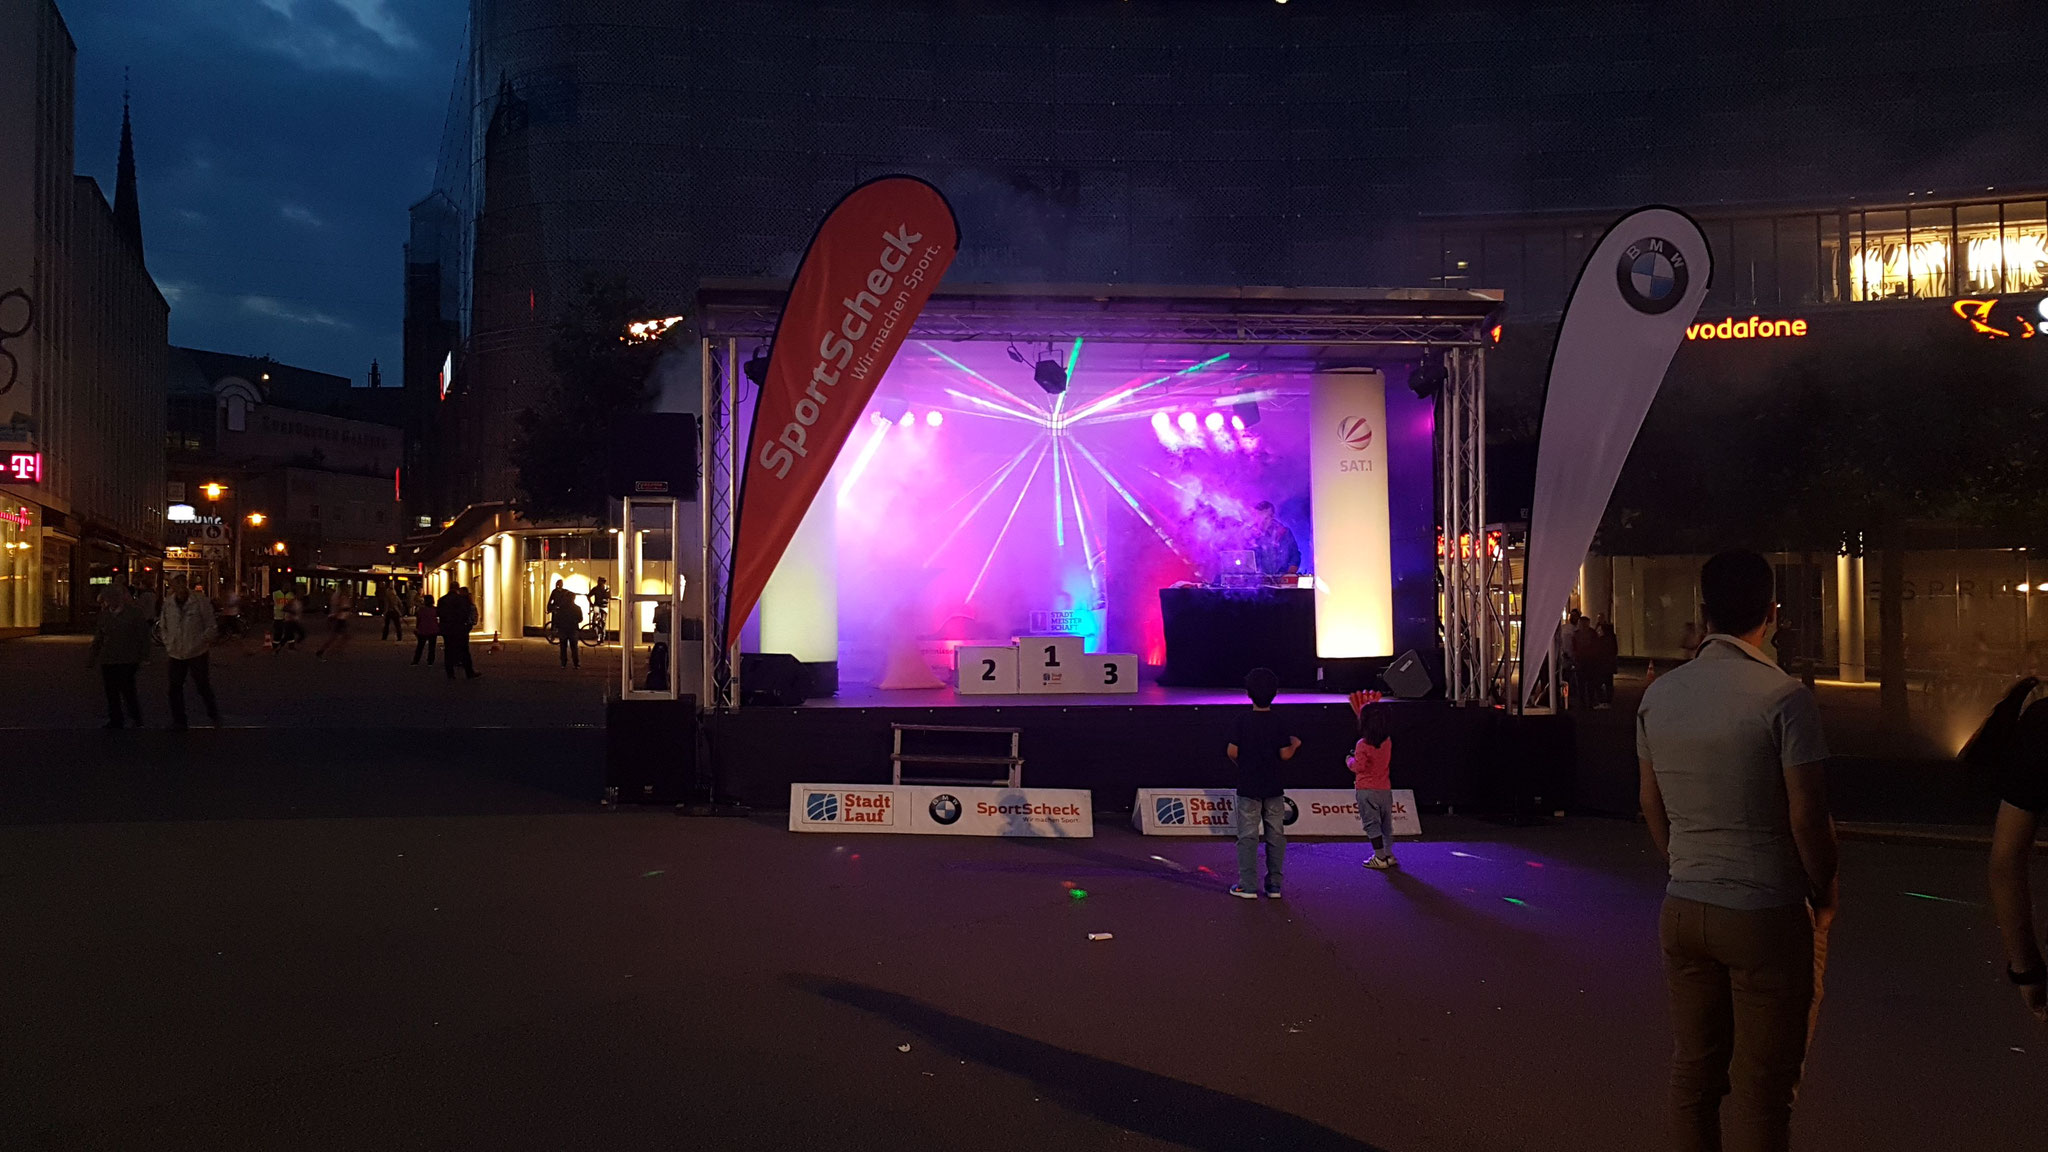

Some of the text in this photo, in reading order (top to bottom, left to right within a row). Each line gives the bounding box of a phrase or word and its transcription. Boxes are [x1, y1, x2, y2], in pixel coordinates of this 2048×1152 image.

[1626, 239, 1685, 268] BMW
[851, 244, 942, 381] Wir machen Sport.
[1686, 315, 1809, 341] vodafone
[759, 222, 923, 480] SportScheck
[1340, 460, 1373, 472] SAT.1
[1044, 645, 1060, 667] 1
[982, 659, 996, 681] 2
[1103, 663, 1118, 685] 3
[845, 794, 891, 808] Stadt
[932, 795, 958, 806] BMW
[1191, 798, 1233, 811] Stadt
[845, 808, 884, 822] Lauf
[977, 802, 1080, 816] SportScheck
[1311, 802, 1407, 816] SportSck
[1192, 811, 1229, 825] Lauf
